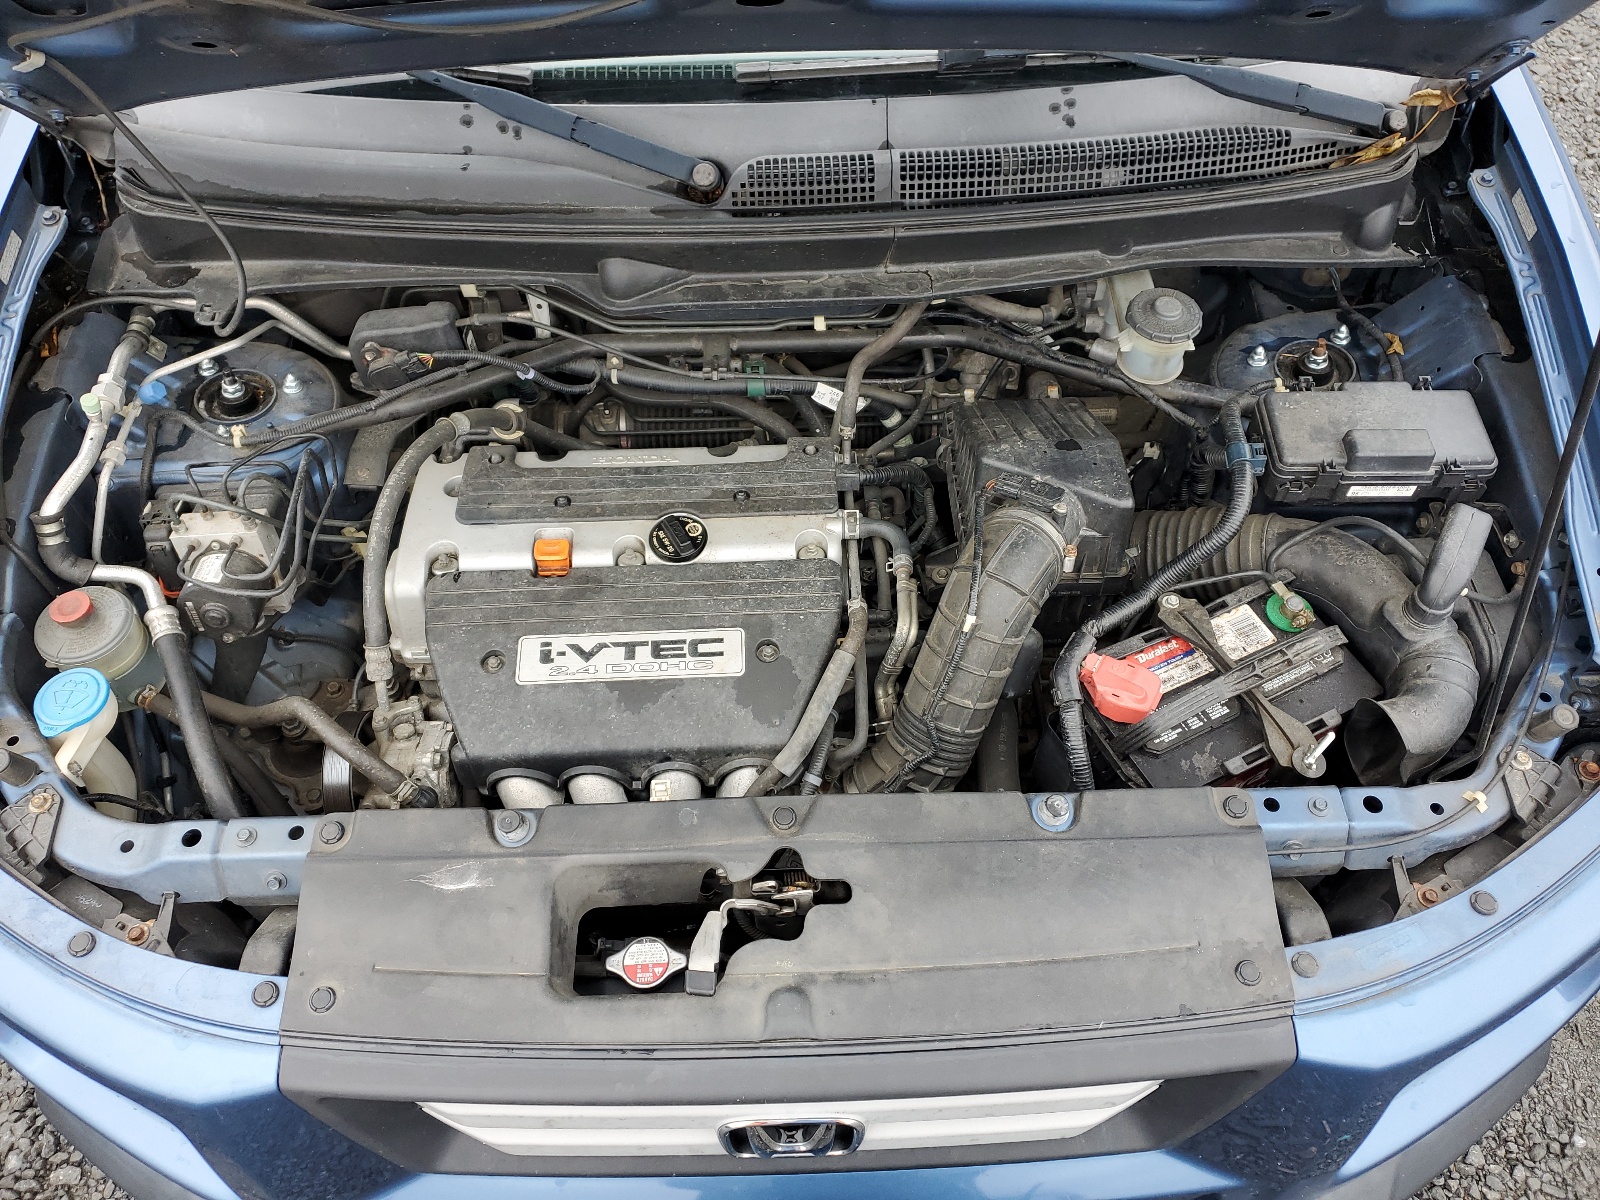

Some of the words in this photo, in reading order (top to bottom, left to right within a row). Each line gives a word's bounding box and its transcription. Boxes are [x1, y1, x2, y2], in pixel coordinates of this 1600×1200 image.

[592, 455, 679, 465] HONDA
[538, 637, 725, 664] i-VTEC
[1133, 639, 1179, 664] Duralast
[549, 664, 599, 677] 2.4
[605, 659, 714, 674] DOHC
